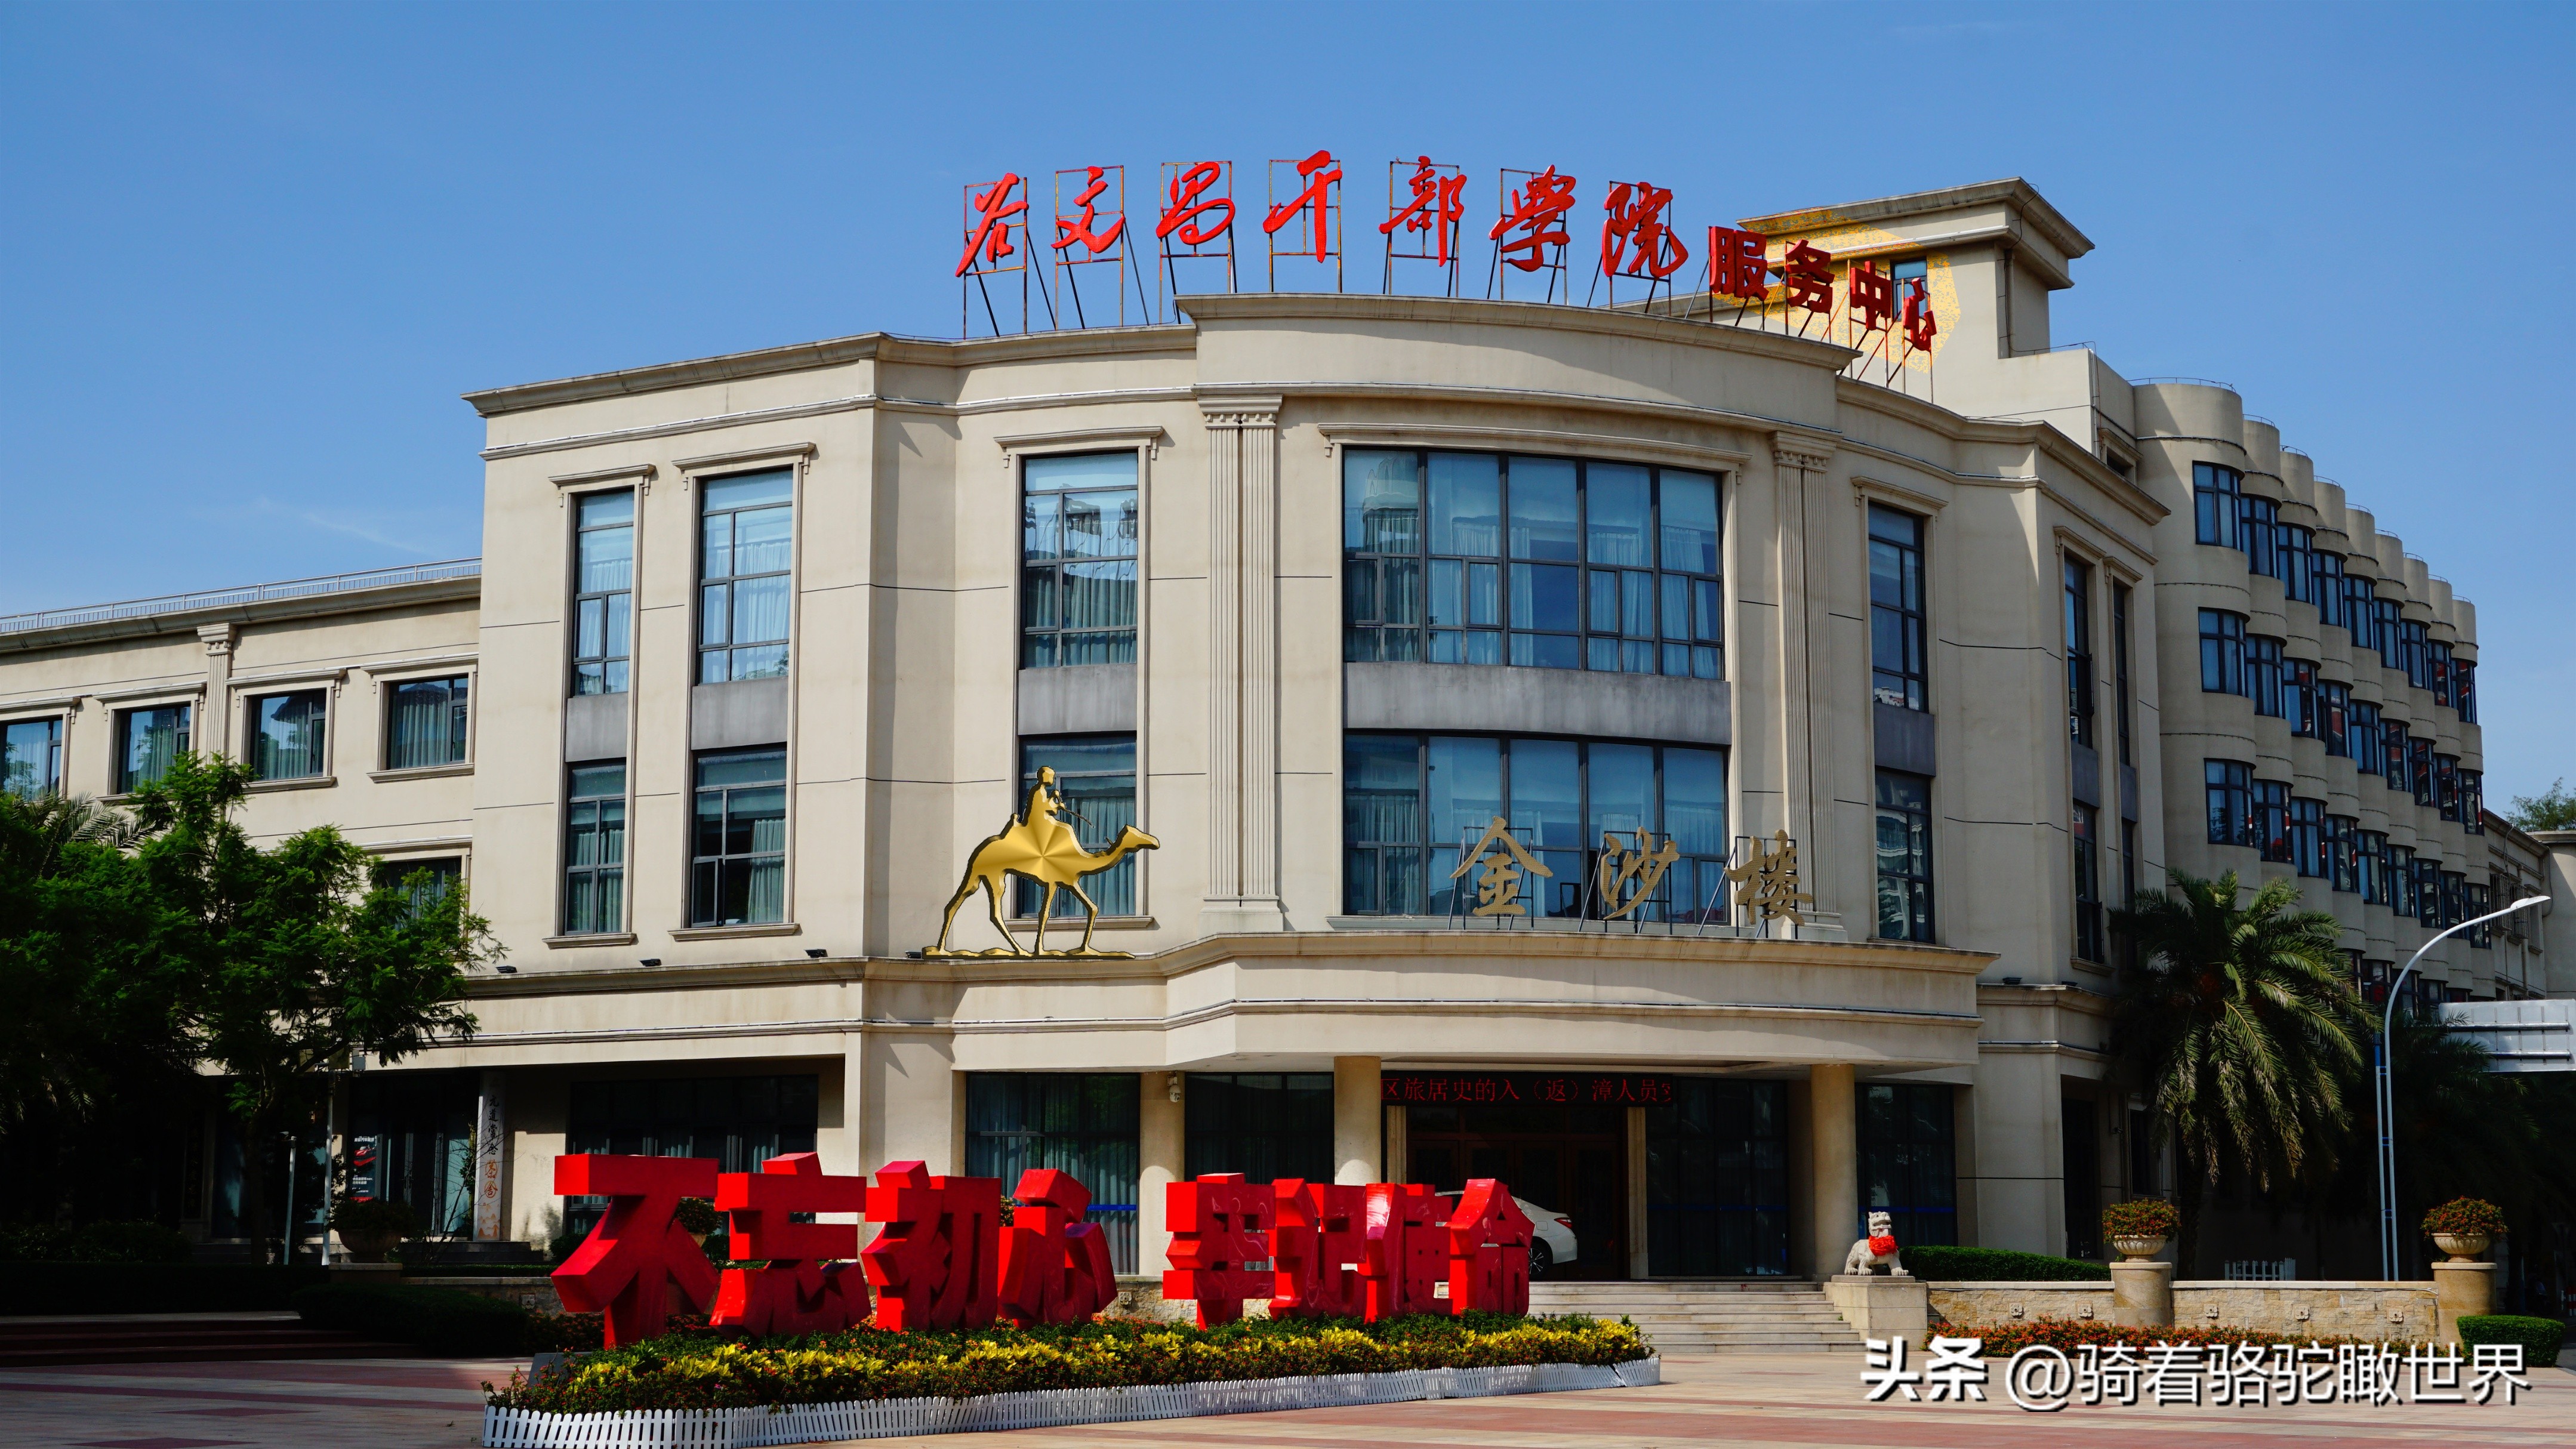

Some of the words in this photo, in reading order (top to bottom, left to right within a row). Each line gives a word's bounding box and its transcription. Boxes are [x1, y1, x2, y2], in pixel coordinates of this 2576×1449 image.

[1708, 226, 1937, 352] 服务中心
[550, 1152, 1118, 1350] 不忘初心
[1162, 1172, 1536, 1331] 牢记使命
